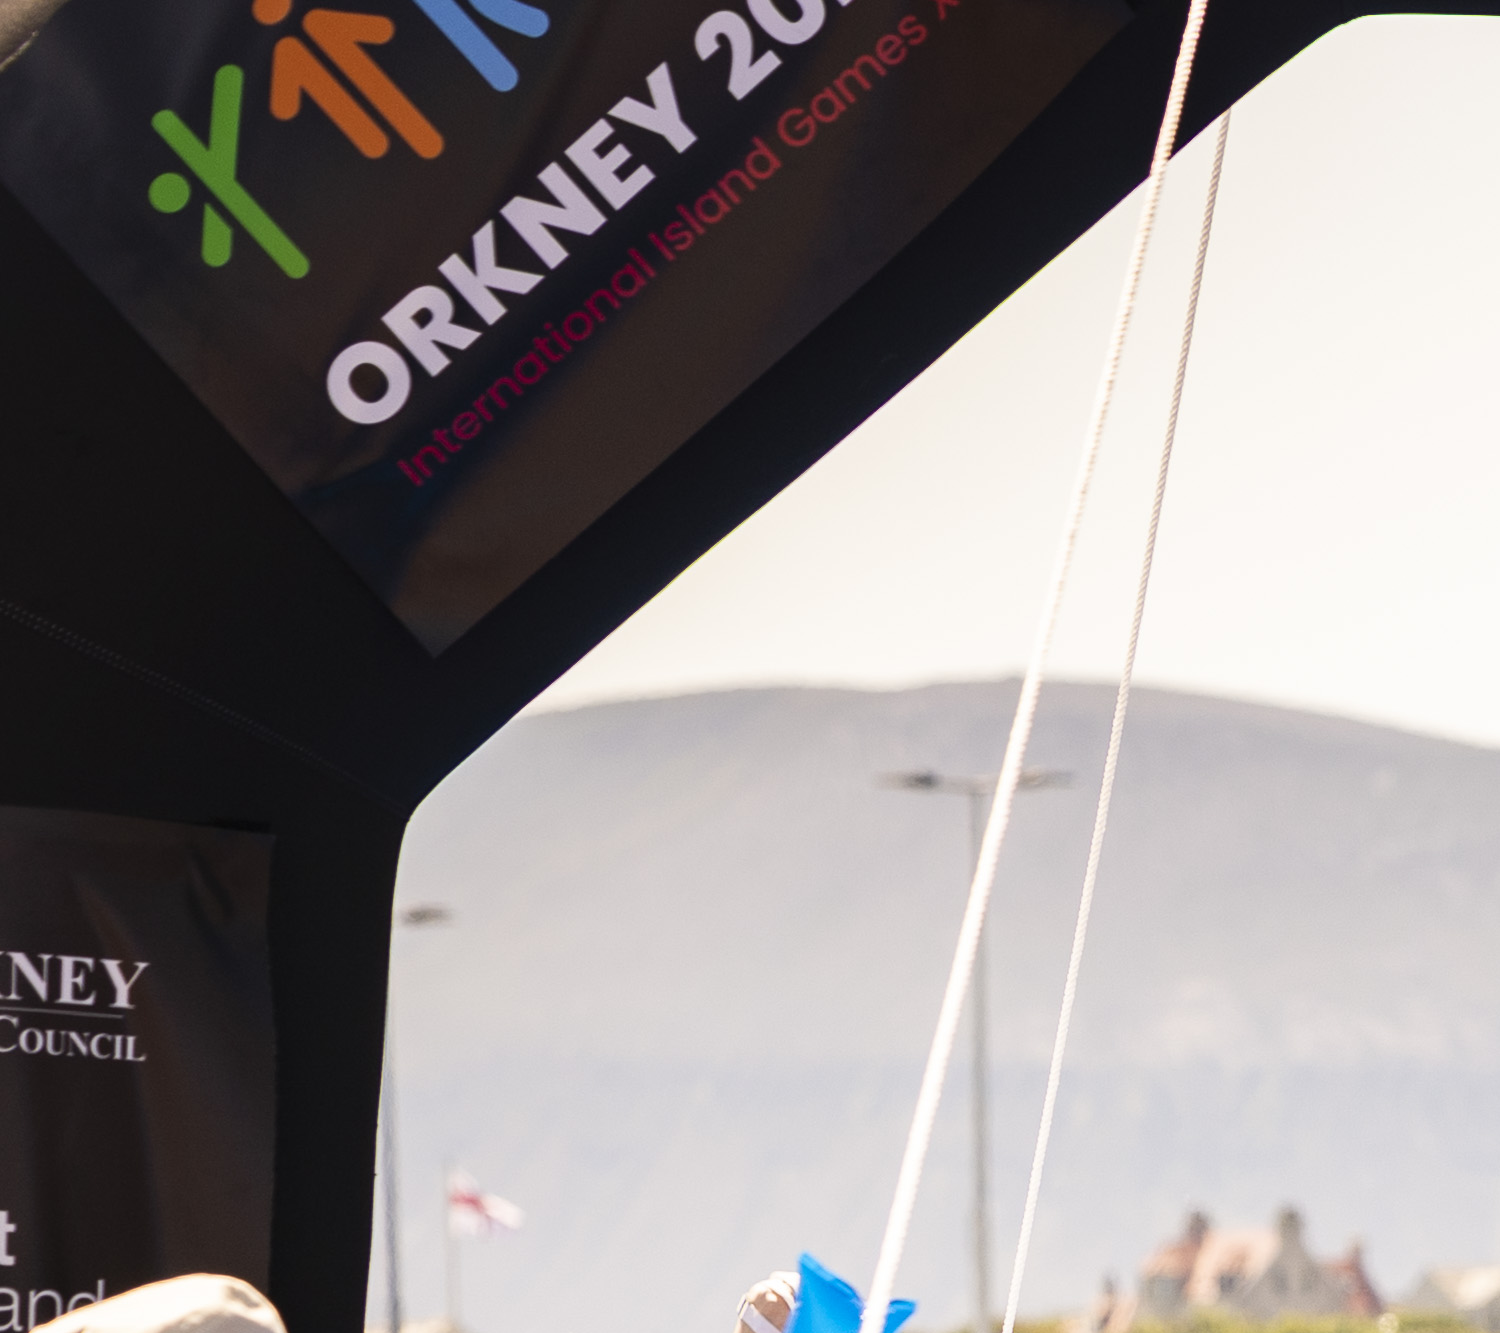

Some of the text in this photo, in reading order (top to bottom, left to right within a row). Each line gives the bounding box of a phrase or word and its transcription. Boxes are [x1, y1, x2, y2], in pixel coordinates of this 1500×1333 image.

[326, 0, 849, 424] ORKNEY 20
[397, 14, 928, 487] International Island Games
[0, 951, 150, 1009] NEY
